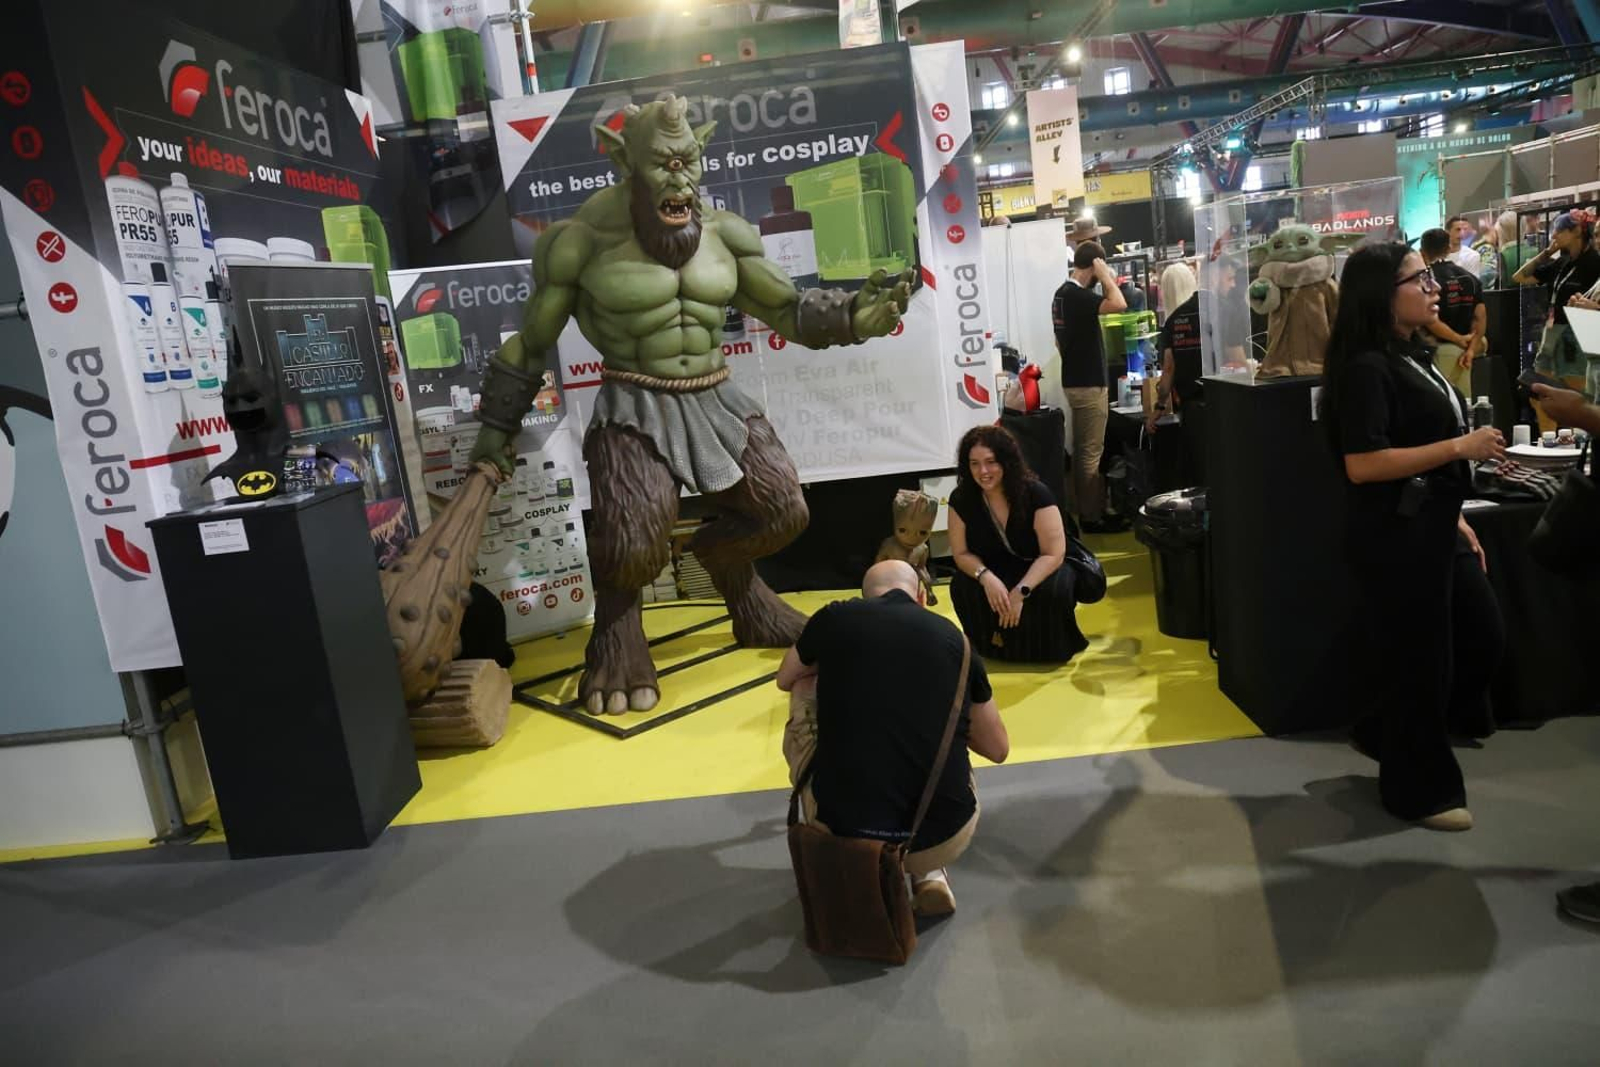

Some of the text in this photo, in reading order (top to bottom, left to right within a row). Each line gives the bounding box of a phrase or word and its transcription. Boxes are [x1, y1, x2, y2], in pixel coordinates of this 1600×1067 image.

[215, 59, 333, 157] feroca
[655, 85, 818, 132] eroca
[727, 150, 755, 169] for
[762, 132, 870, 164] cosplay
[1035, 130, 1063, 143] ALLEY
[137, 135, 360, 201] your ideas, our materials
[529, 170, 615, 198] the best
[119, 223, 157, 242] PR55
[166, 213, 195, 228] PUR
[1313, 215, 1395, 232] BADLANDS
[447, 280, 531, 309] feroca
[954, 263, 987, 367] feroca
[794, 365, 837, 382] Eva
[846, 358, 879, 376] Air
[418, 384, 434, 394] FX
[864, 400, 916, 417] Pour
[66, 346, 138, 516] feroca
[525, 503, 571, 521] COSPLAY
[500, 574, 583, 602] feroca.com
